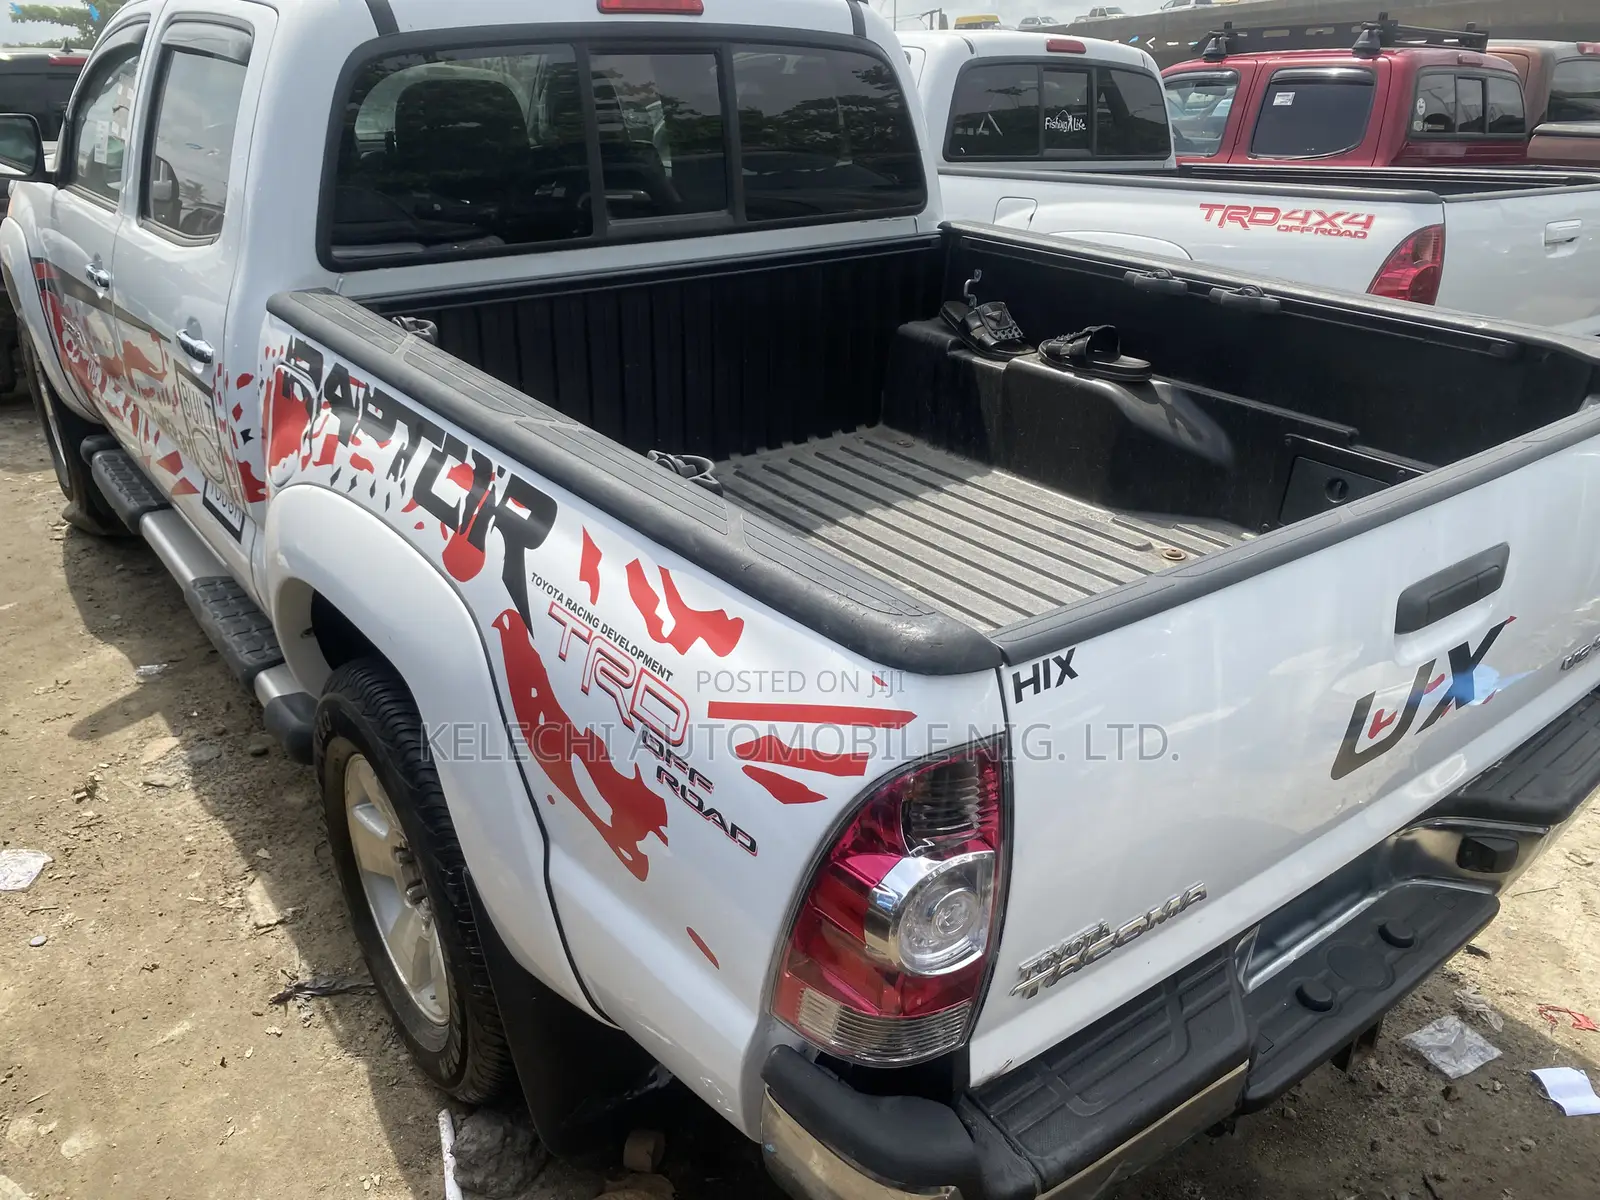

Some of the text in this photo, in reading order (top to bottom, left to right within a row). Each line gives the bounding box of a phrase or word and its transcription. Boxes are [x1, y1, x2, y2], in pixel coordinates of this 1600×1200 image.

[1199, 203, 1282, 231] TRD
[1276, 224, 1369, 240] OFF ROAD
[180, 380, 216, 441] BUILT
[282, 334, 559, 641] RAPTOR
[531, 572, 674, 683] TOYOTA RACING DEVELOPMENT
[547, 600, 690, 748] TRD
[1012, 646, 1079, 704] HIX
[642, 729, 715, 794] OFF
[656, 764, 758, 857] ROAD
[1008, 881, 1208, 1000] TACOMA
[1018, 918, 1112, 980] TOYOTA
